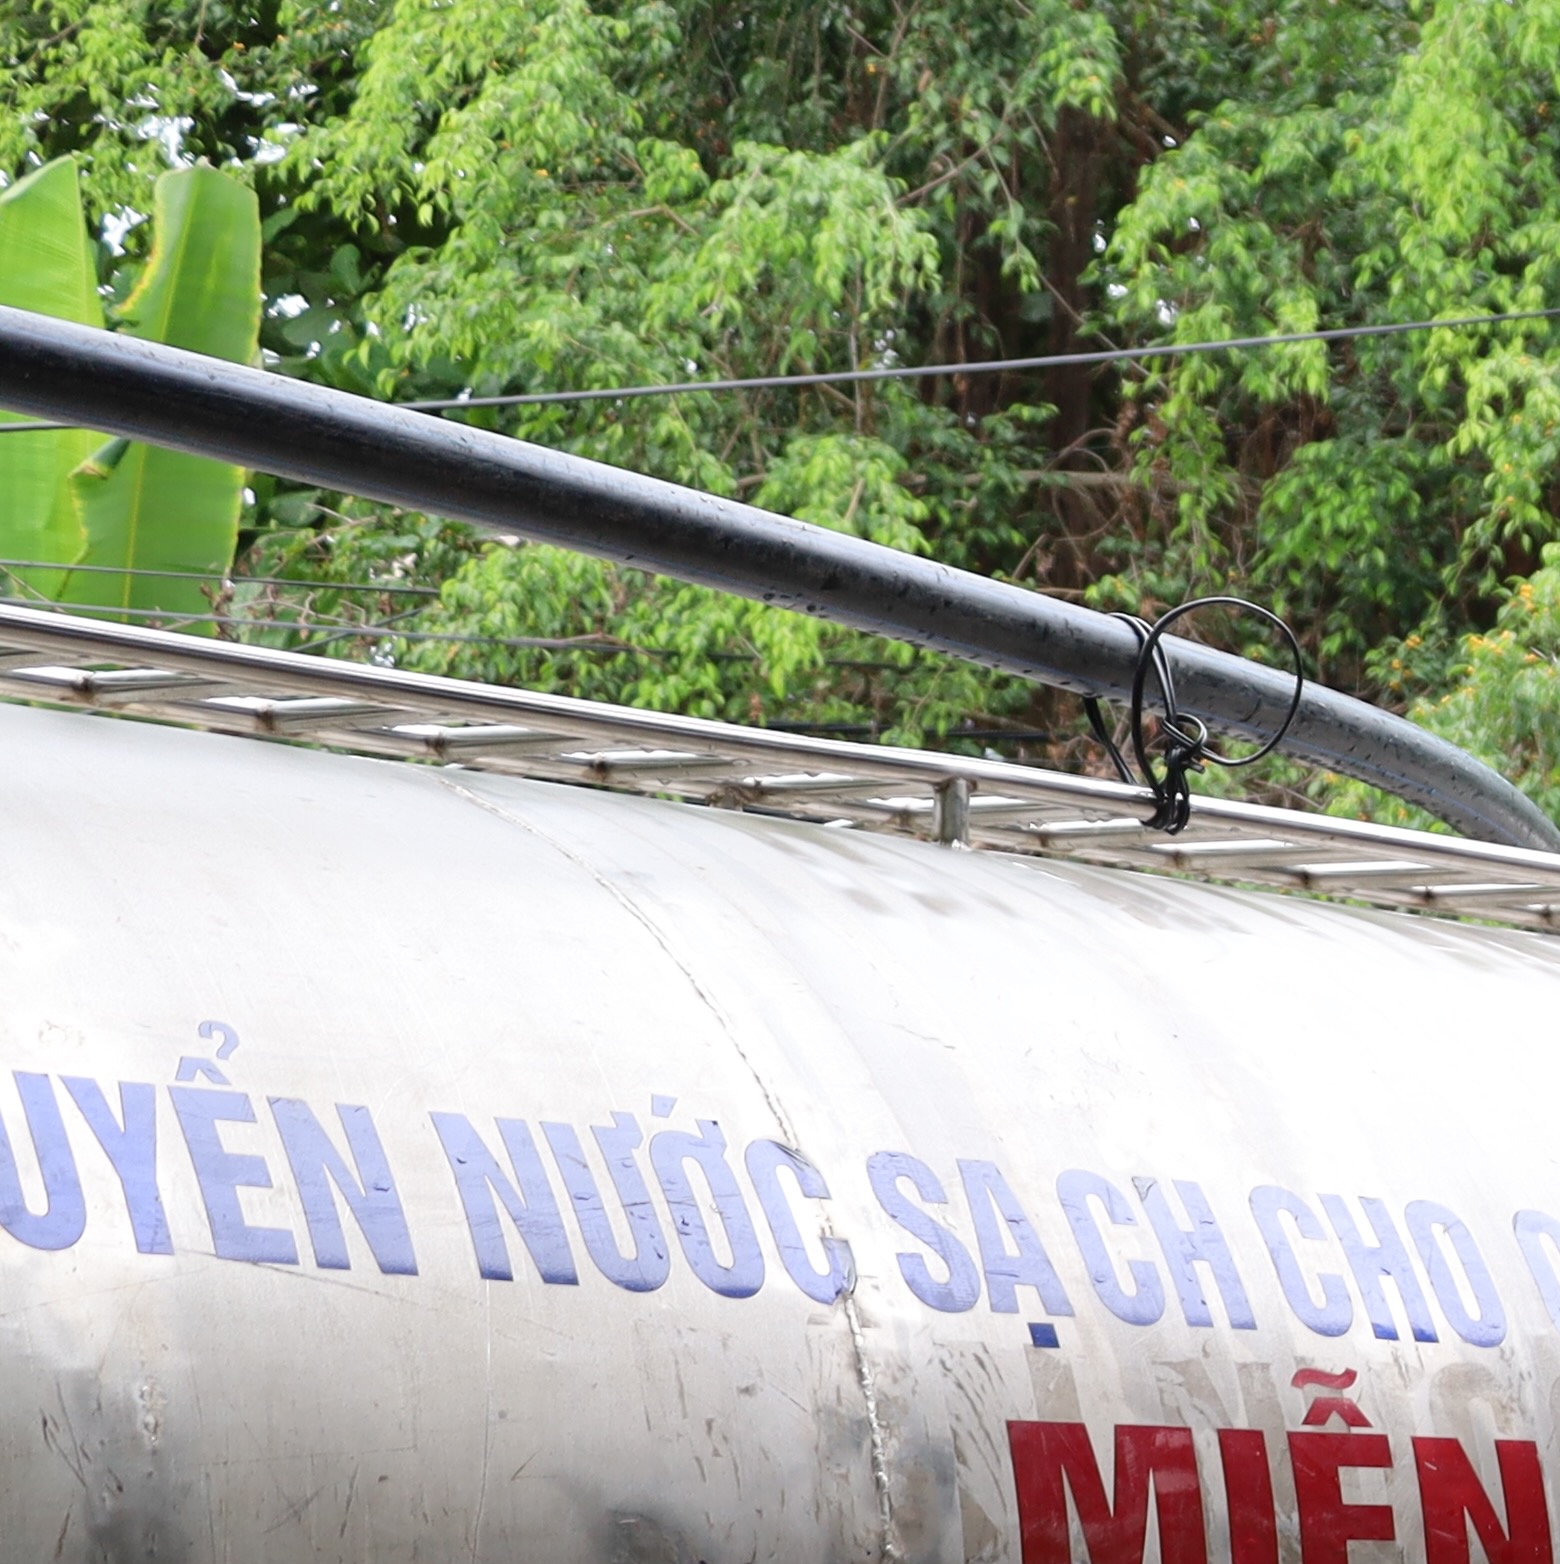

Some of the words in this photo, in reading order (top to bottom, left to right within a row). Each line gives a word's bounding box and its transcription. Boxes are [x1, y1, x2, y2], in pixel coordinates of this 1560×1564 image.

[430, 1093, 857, 1305] NƯỚC
[868, 1150, 1256, 1348] SẠCH
[1247, 1182, 1506, 1348] CHO
